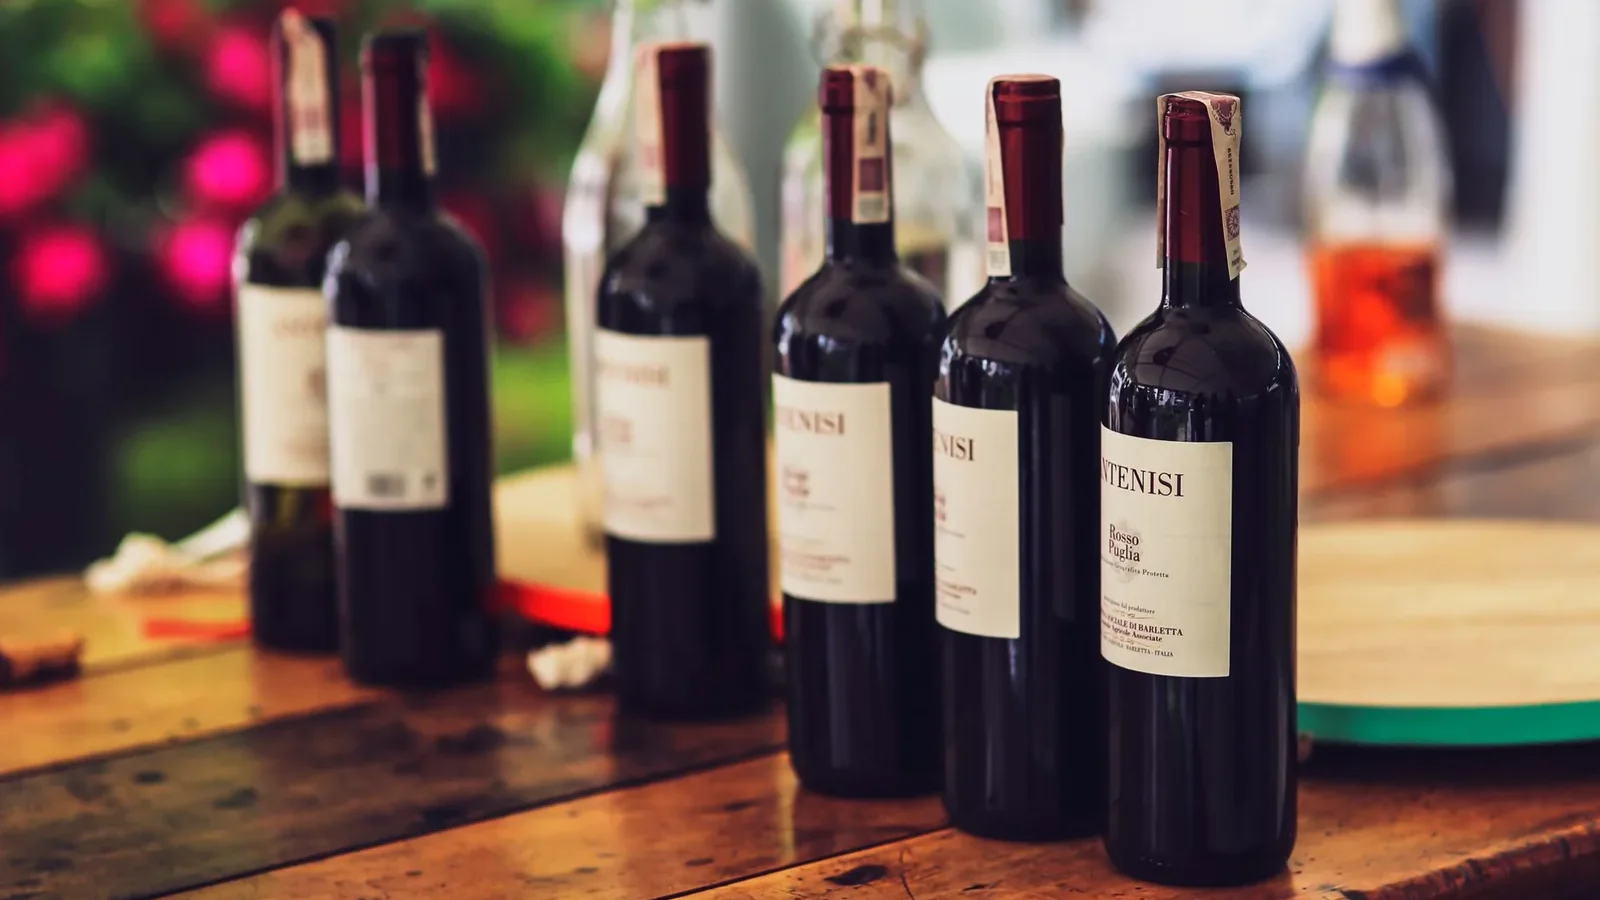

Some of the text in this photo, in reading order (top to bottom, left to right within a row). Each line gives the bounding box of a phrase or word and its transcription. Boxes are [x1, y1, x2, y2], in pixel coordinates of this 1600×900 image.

[1109, 524, 1139, 546] Rosso
[1108, 539, 1141, 563] Puglia
[1142, 568, 1169, 578] Protetta
[1129, 622, 1137, 631] DI
[1138, 623, 1184, 637] BARLETTA
[1131, 630, 1163, 642] Associate
[1154, 649, 1174, 658] ITALIA
